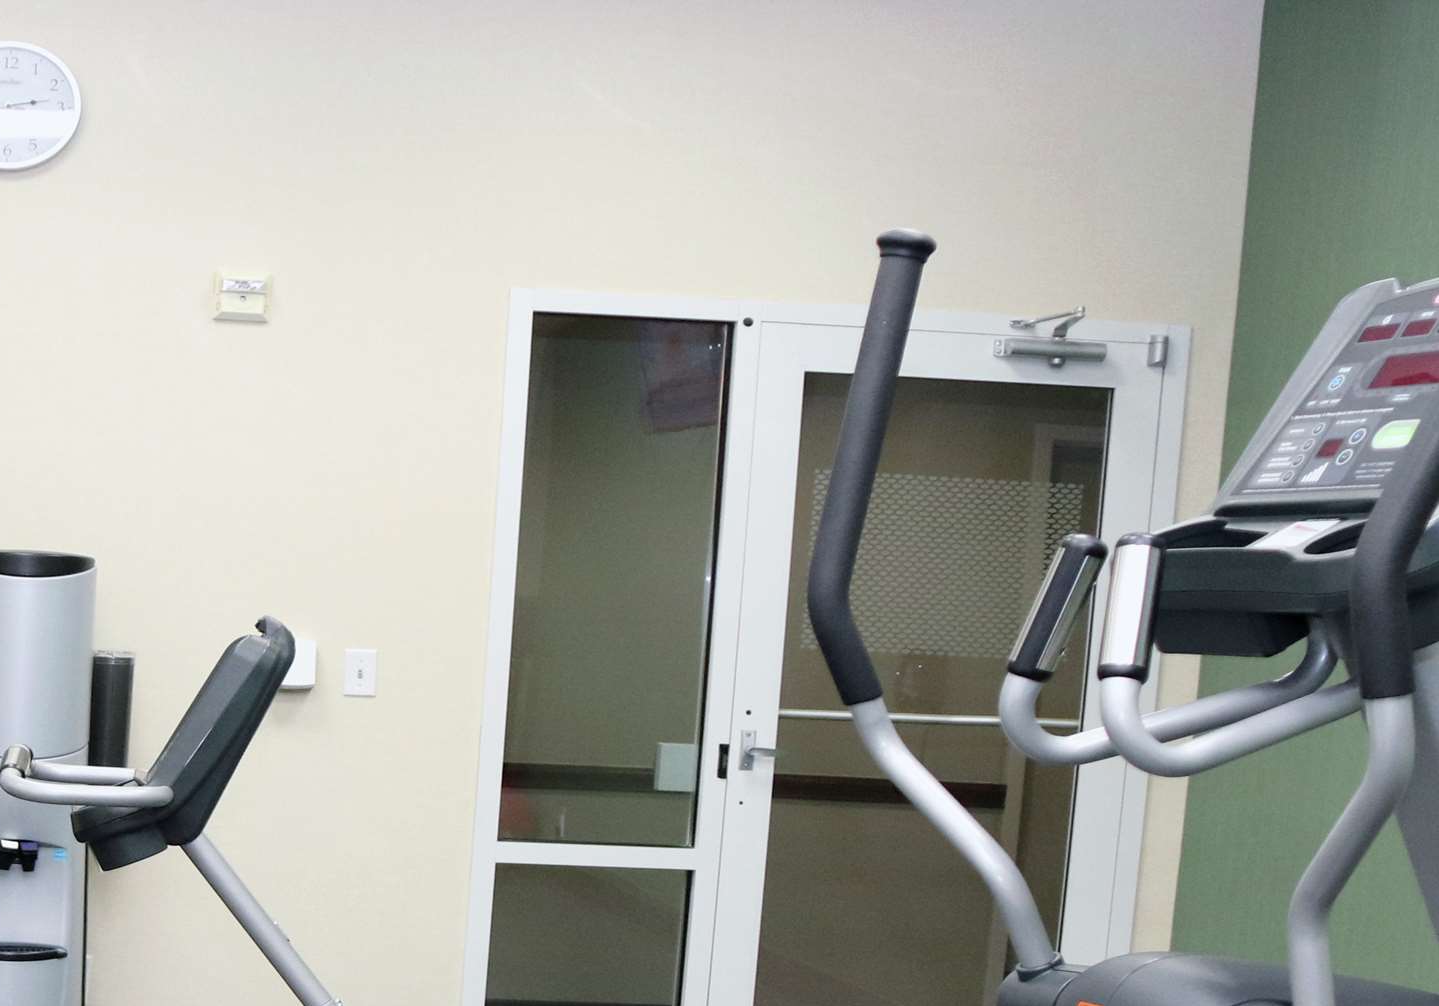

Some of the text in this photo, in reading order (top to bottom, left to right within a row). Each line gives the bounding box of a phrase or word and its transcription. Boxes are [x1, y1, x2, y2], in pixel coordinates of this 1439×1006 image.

[4, 57, 19, 69] 12
[33, 63, 38, 75] 1
[50, 79, 59, 91] 2
[3, 144, 12, 156] 6
[29, 138, 38, 151] 5
